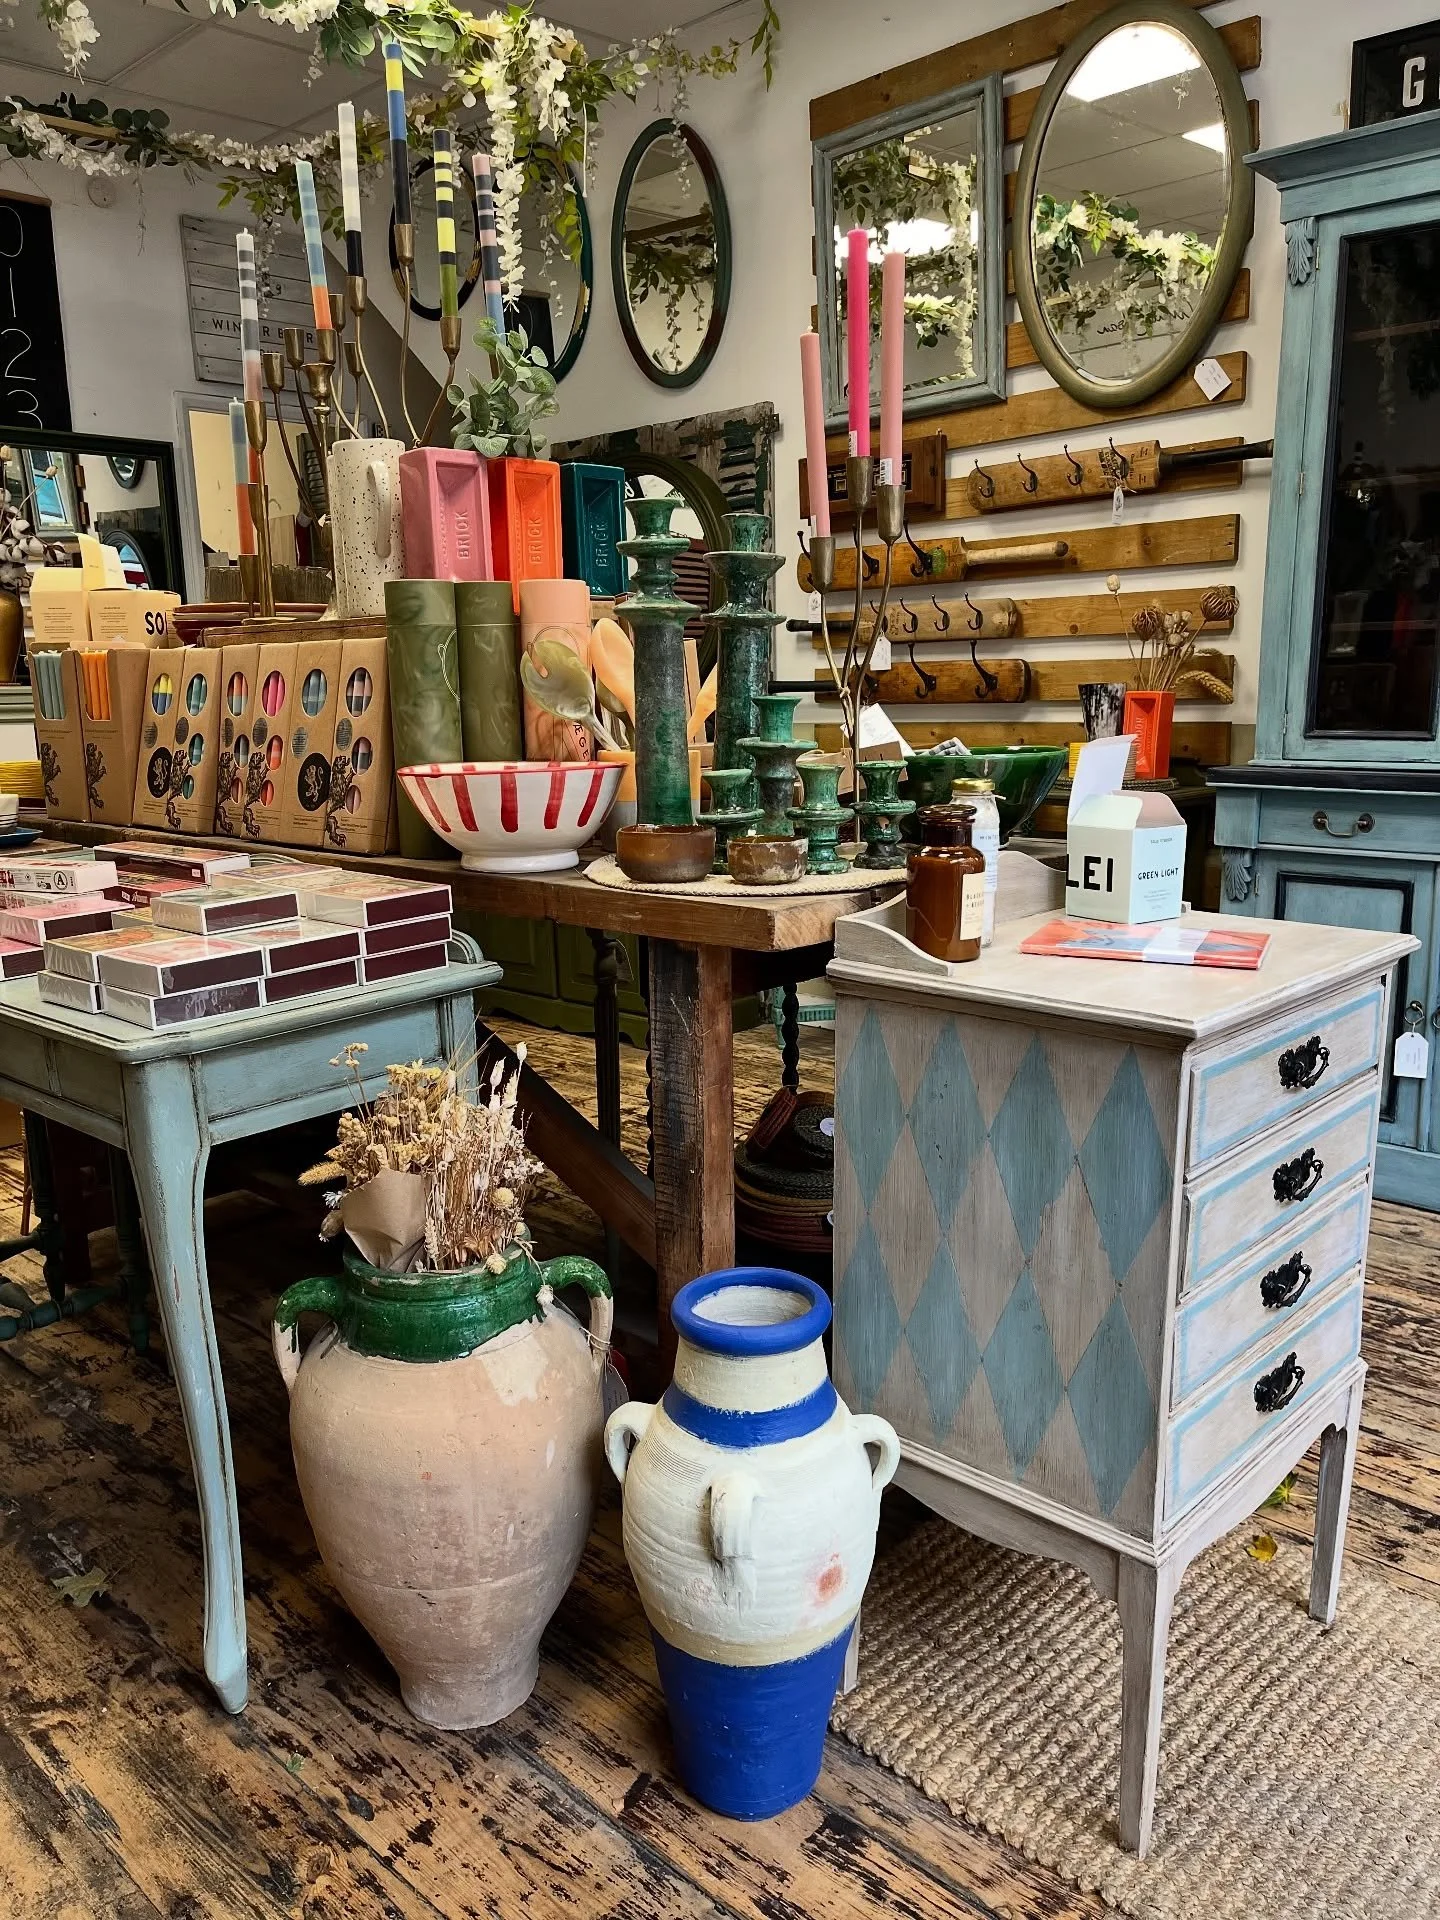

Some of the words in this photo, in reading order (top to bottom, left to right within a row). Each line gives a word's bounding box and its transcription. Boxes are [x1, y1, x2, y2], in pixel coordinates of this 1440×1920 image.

[212, 318, 270, 337] WINR
[1, 328, 37, 380] 2
[455, 510, 472, 560] BRICK
[528, 517, 544, 564] BRICK
[595, 521, 609, 567] BRICK
[145, 611, 168, 635] SO
[1138, 870, 1159, 880] GREEN
[1161, 867, 1179, 877] LIGHT
